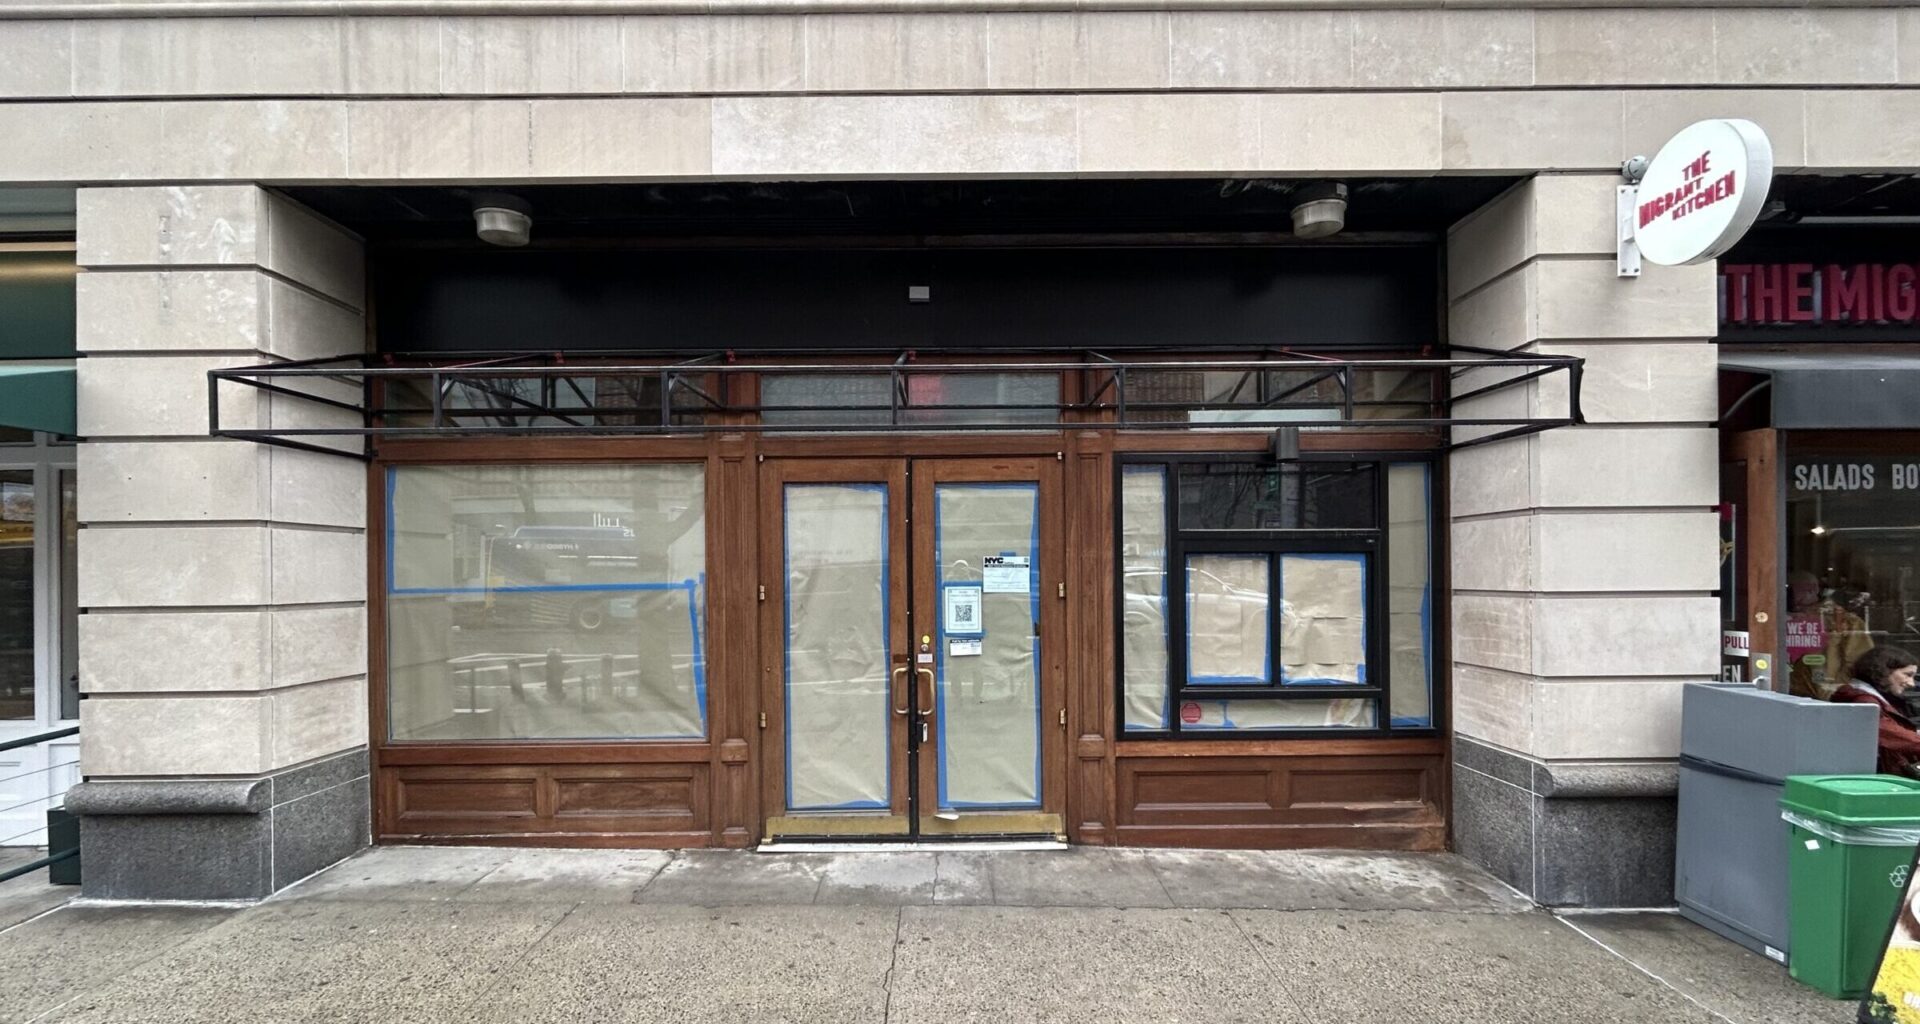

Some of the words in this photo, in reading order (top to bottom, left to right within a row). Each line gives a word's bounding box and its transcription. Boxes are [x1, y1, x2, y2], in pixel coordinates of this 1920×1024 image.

[1682, 150, 1711, 181] THE
[1639, 176, 1704, 230] MIGRANT
[1672, 170, 1735, 221] KITCHEN
[1724, 264, 1813, 321] THE
[1826, 263, 1917, 321] MIG
[1795, 463, 1875, 490] SALADS
[1892, 463, 1920, 490] BO
[1785, 634, 1822, 648] HIRING!
[1787, 620, 1819, 634] WE'RE
[1724, 635, 1749, 650] PULL
